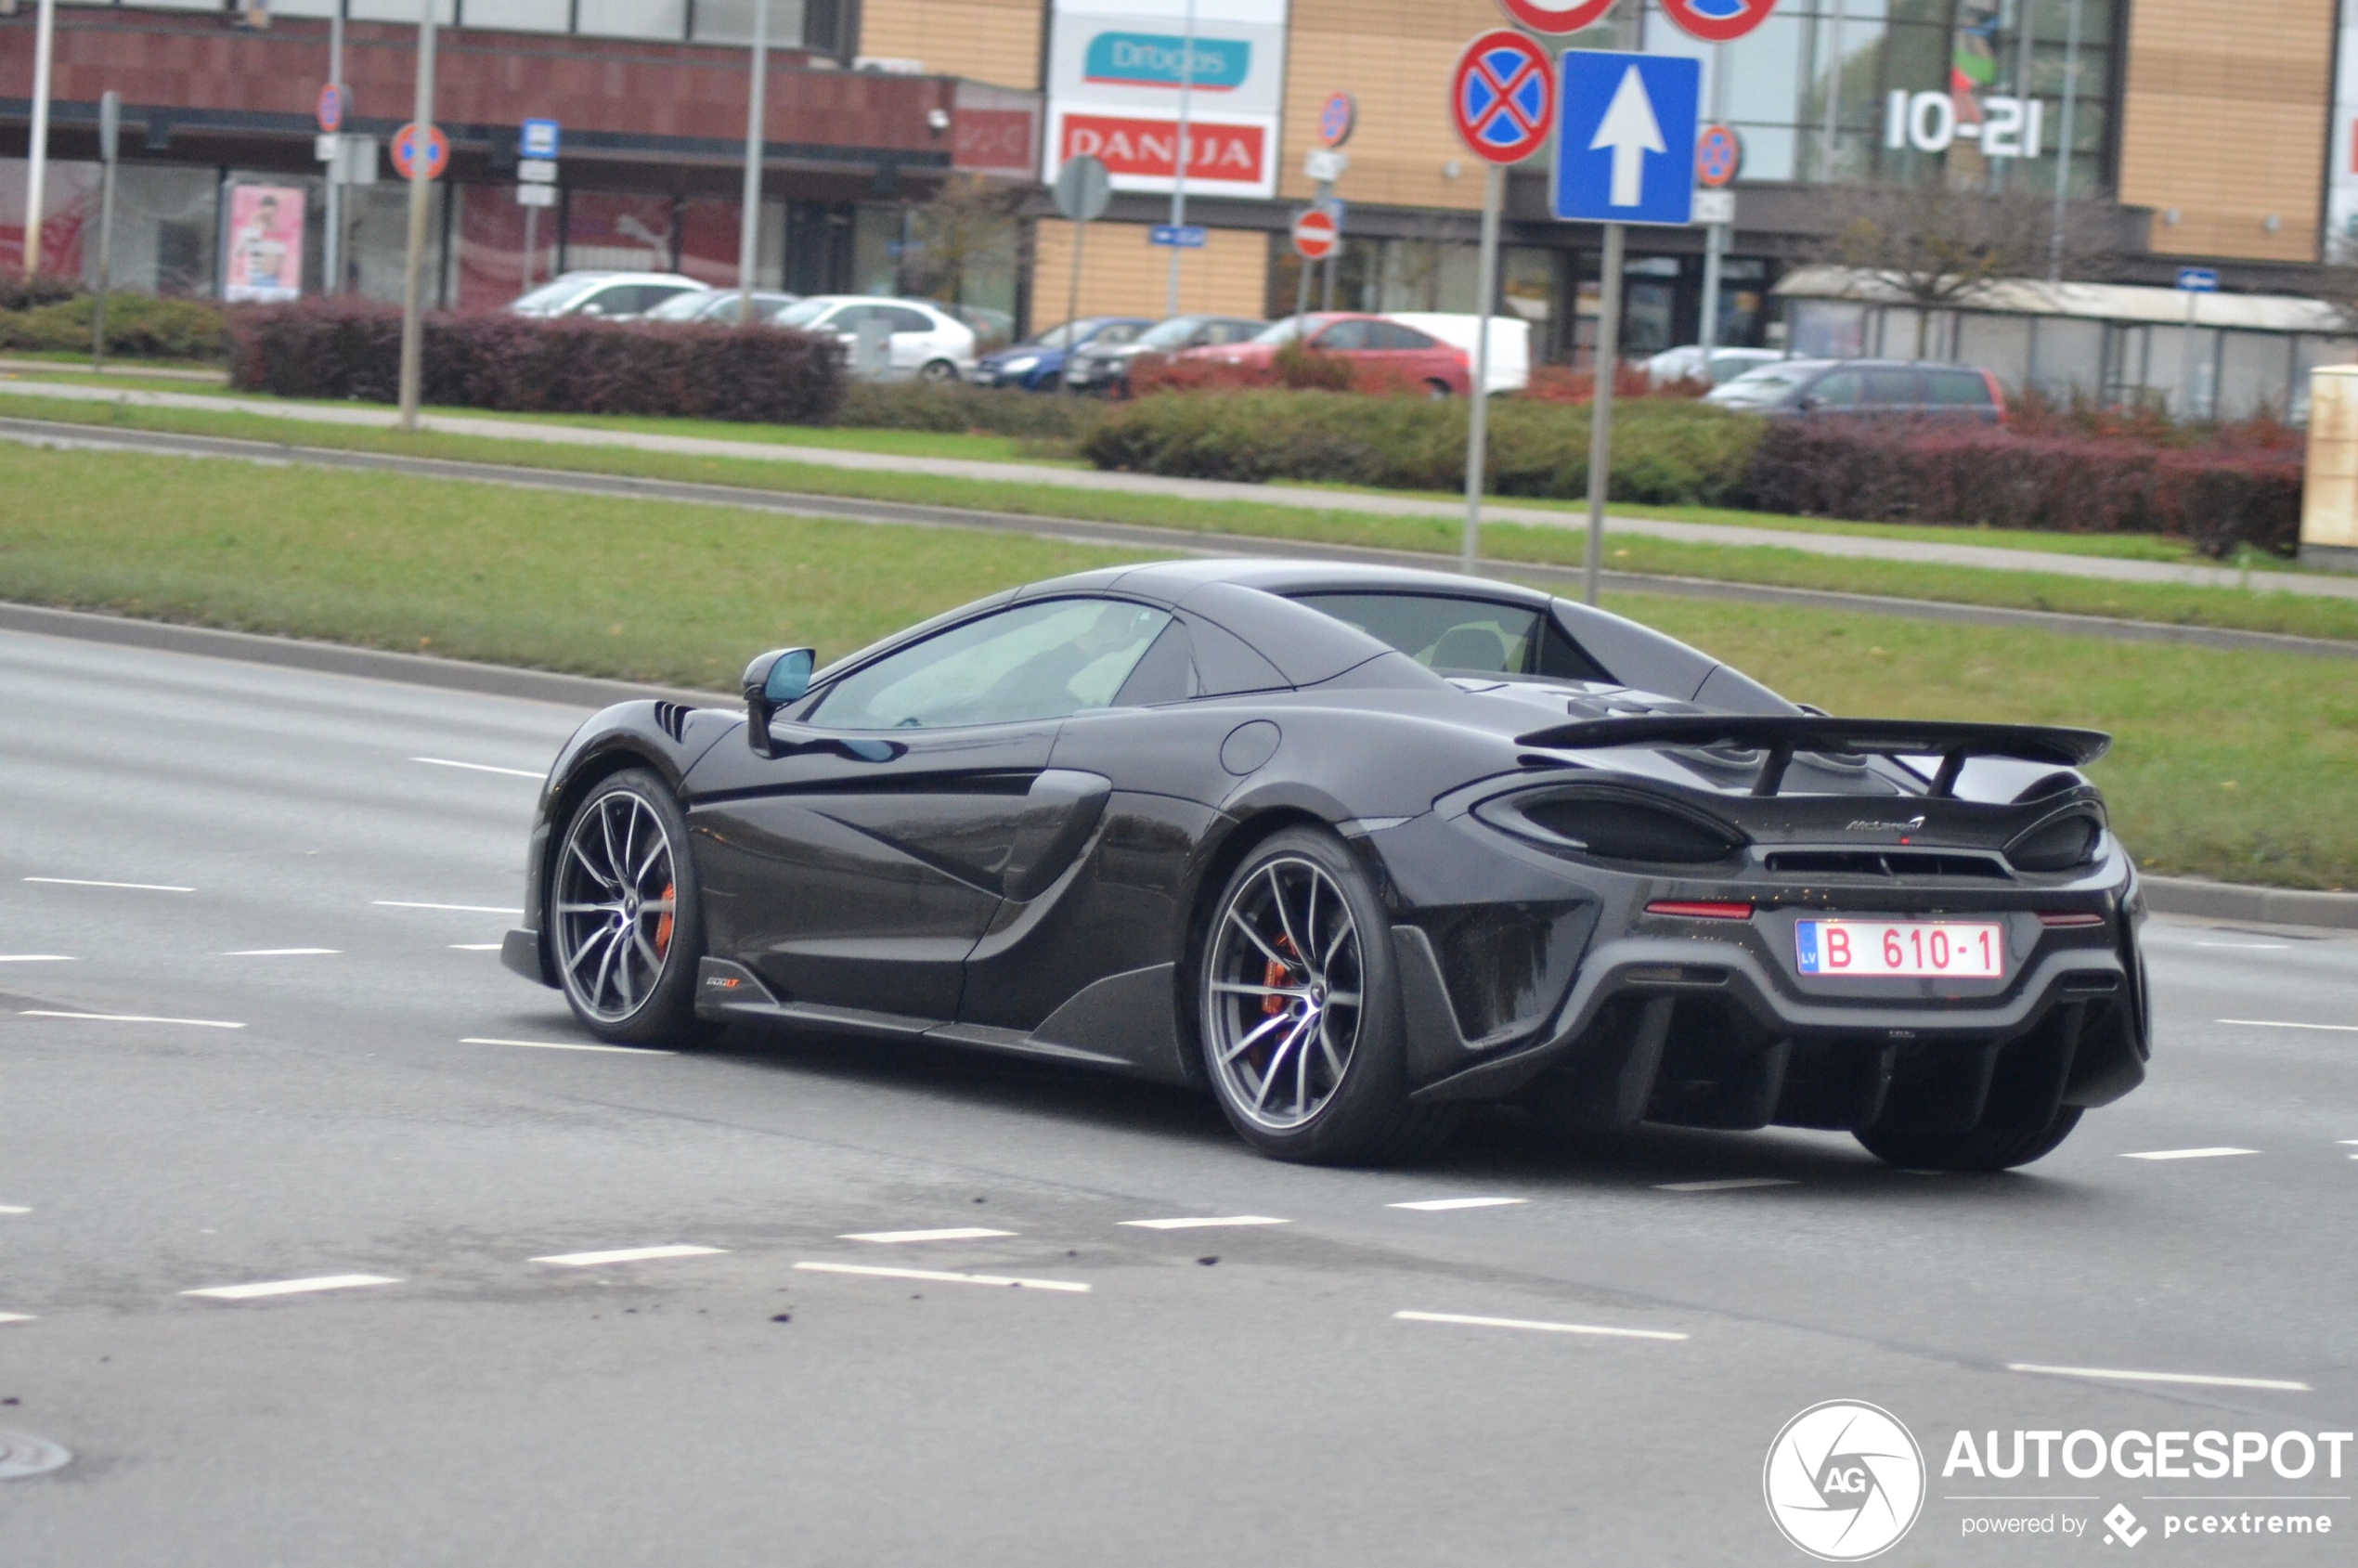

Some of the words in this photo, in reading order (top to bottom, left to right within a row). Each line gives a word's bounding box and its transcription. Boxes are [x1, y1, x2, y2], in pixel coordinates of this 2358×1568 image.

[1884, 90, 2043, 159] 10-21
[1069, 128, 1253, 170] DANIJA
[1801, 952, 1817, 965] LV
[1826, 928, 1852, 968] B
[1883, 929, 1990, 970] 610-1
